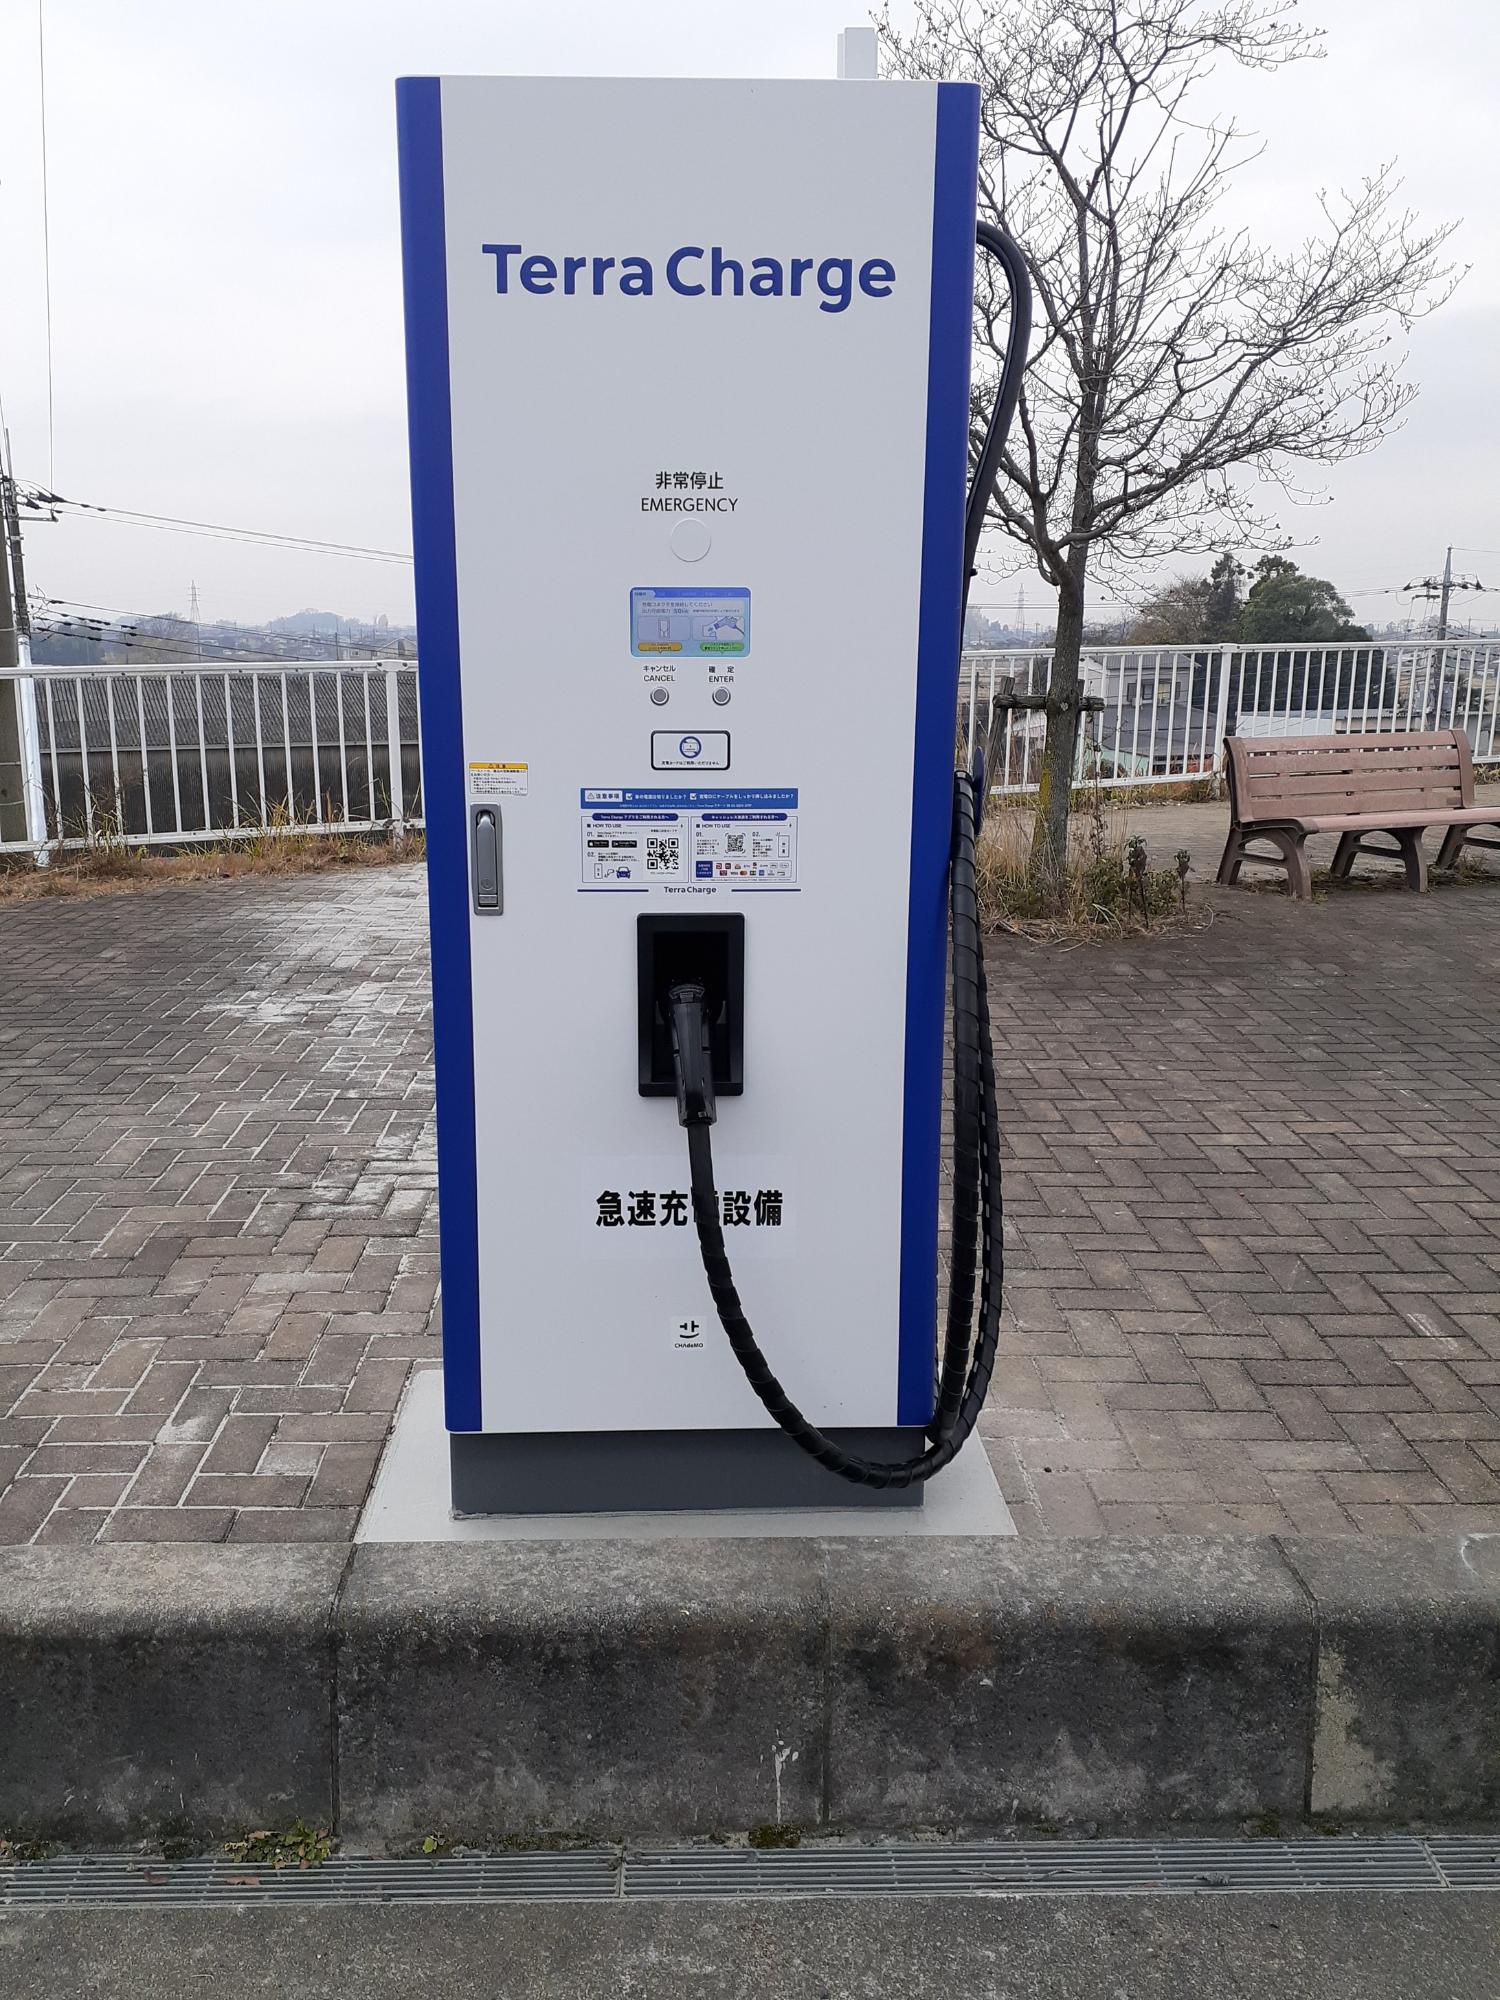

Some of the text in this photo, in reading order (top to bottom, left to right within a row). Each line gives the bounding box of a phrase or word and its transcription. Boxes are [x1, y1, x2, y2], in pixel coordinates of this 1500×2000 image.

[482, 243, 896, 313] Terra Charge
[655, 471, 724, 490] 非常停止
[641, 498, 739, 512] EMERGENCY
[708, 675, 735, 683] ENTER
[686, 886, 717, 895] Charge
[595, 1190, 783, 1226] 急速充設備
